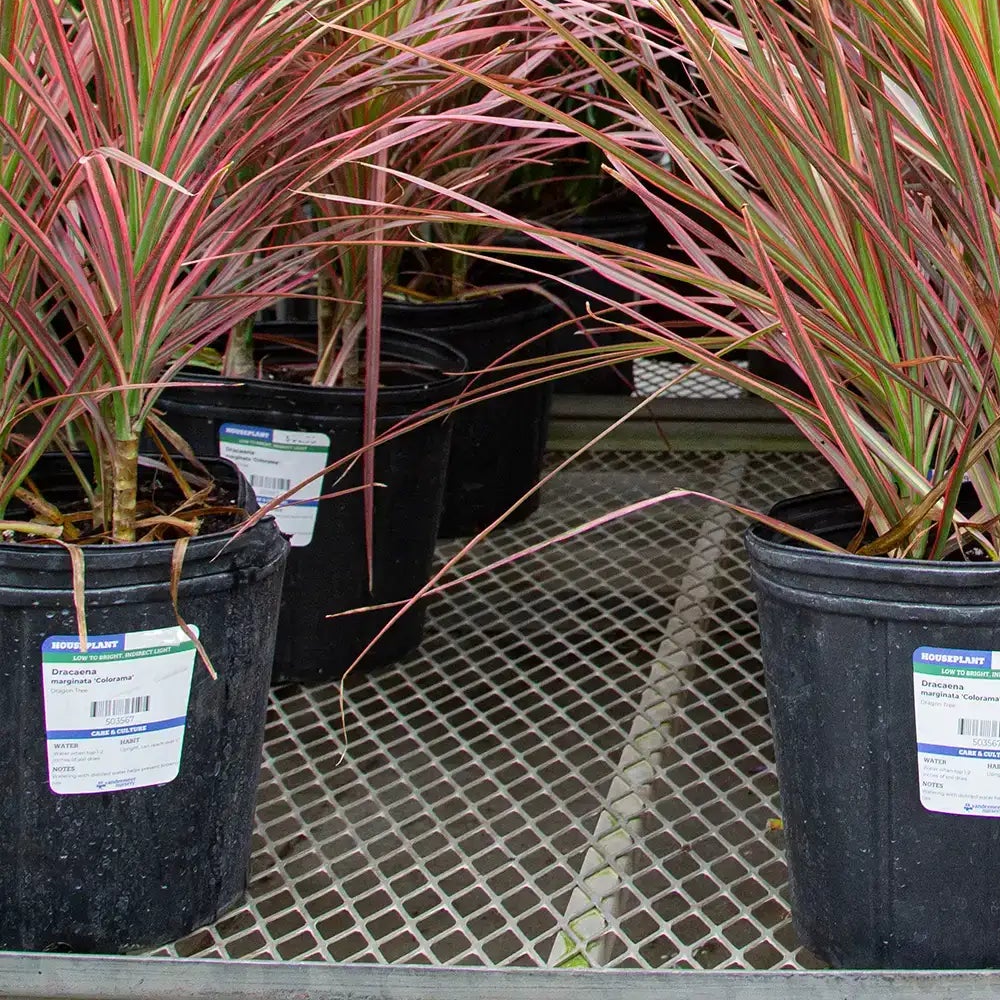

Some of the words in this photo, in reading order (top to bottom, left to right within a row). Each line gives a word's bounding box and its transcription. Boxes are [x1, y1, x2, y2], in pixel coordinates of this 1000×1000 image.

[51, 640, 119, 650] HOUSPLANT
[125, 650, 152, 658] INDIRECT
[921, 652, 985, 665] HOUSEPLANT
[51, 668, 97, 676] Dracaena
[51, 678, 92, 686] marginata
[94, 674, 135, 684] 'Colorama'
[921, 680, 964, 691] Dracaena
[920, 690, 960, 700] marginata
[105, 716, 135, 725] 503567
[91, 729, 109, 737] CARE
[117, 725, 147, 735] CULTURE
[120, 737, 141, 745] HABIT
[958, 749, 977, 757] CARE
[924, 757, 947, 765] WATER
[922, 781, 943, 789] NOTES
